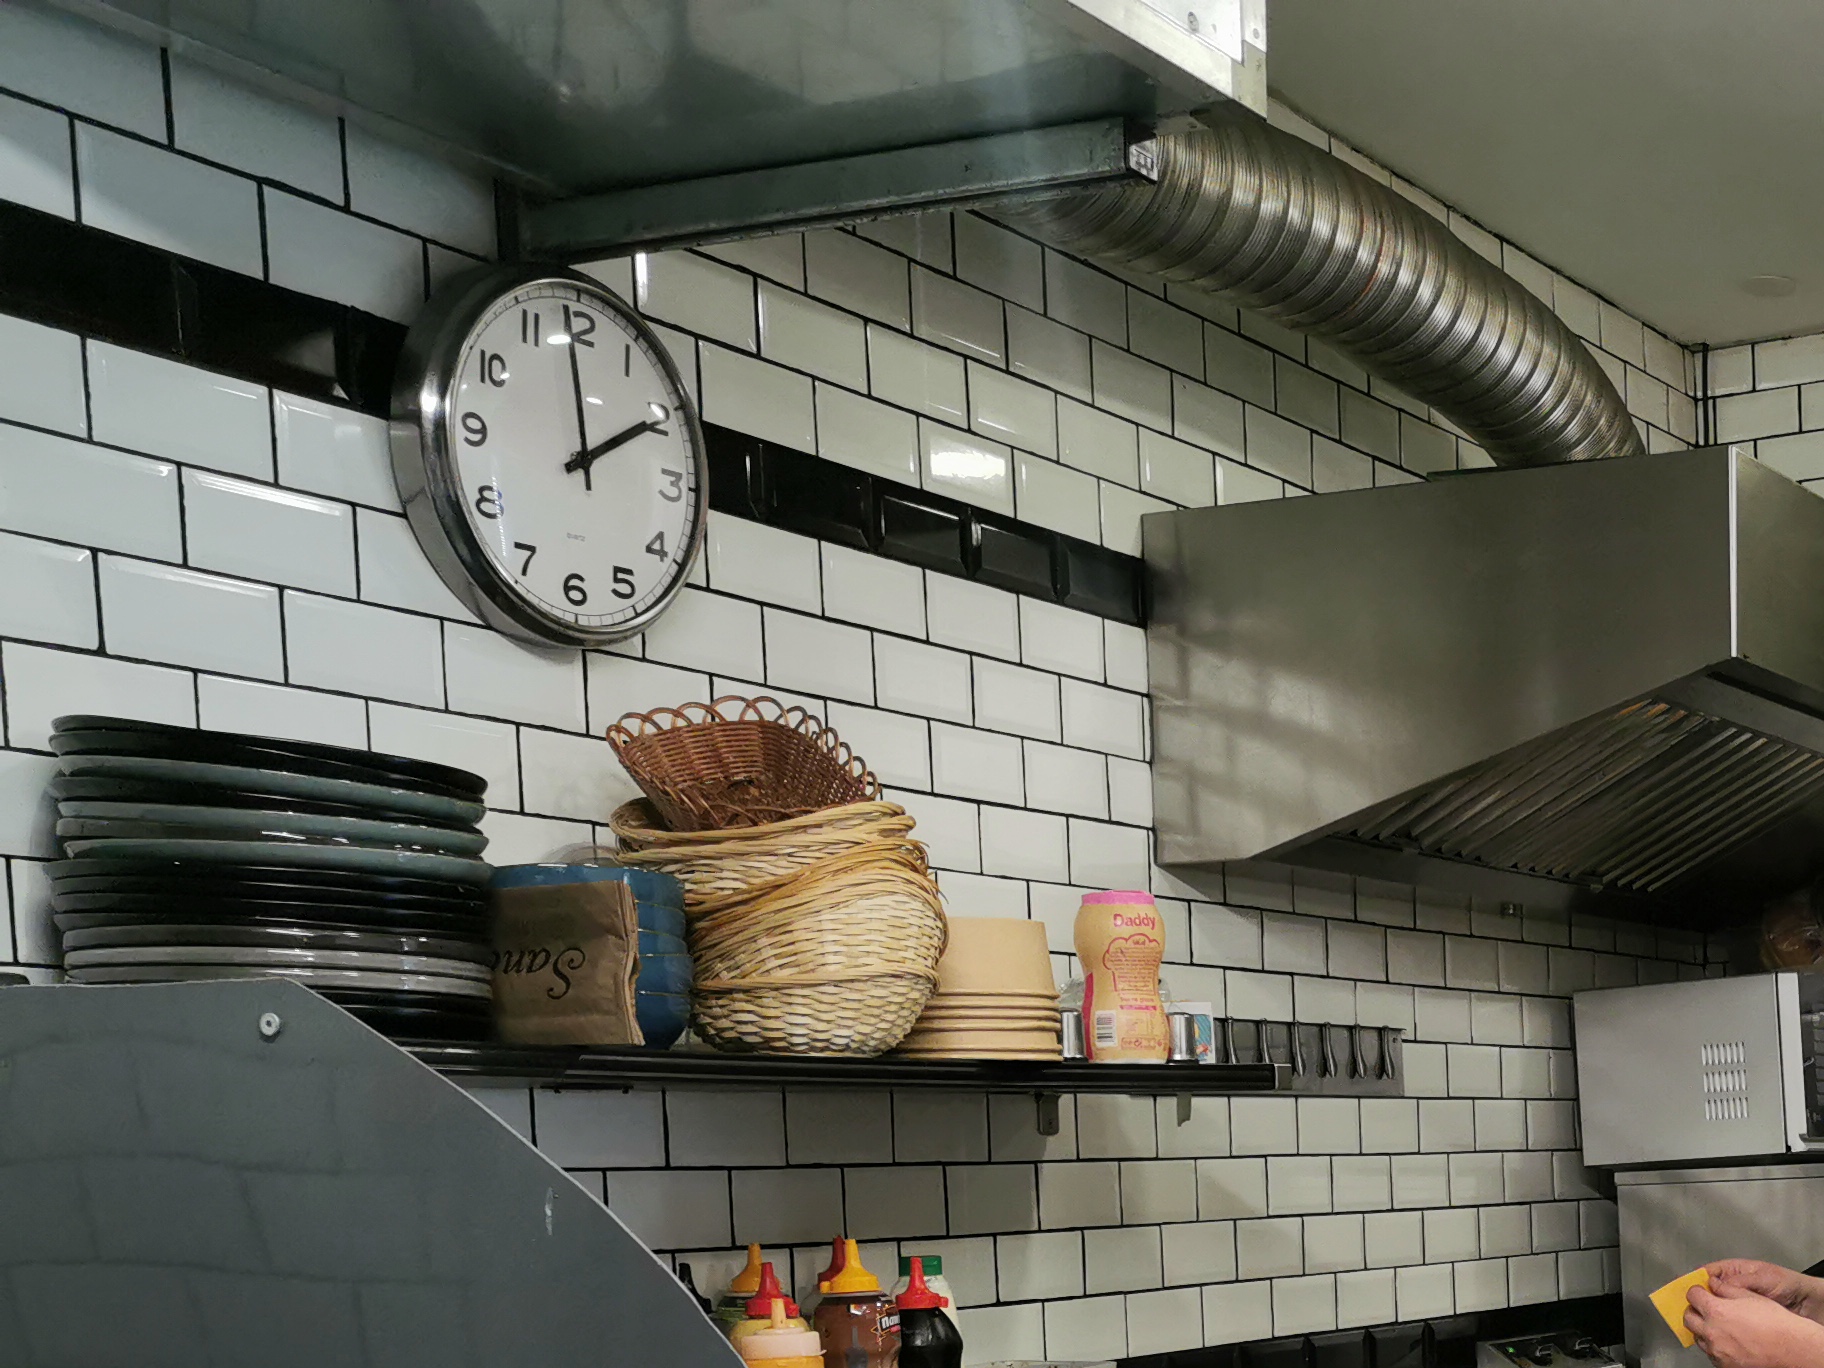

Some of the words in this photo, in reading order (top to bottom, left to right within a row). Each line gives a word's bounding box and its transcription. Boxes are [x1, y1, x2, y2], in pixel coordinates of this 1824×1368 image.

[522, 308, 539, 346] 11
[480, 349, 507, 387] 10
[625, 343, 631, 377] 1
[461, 412, 488, 447] 9
[475, 485, 504, 519] 8
[658, 468, 683, 503] 3
[514, 541, 537, 576] 7
[646, 531, 668, 562] 4
[563, 573, 588, 607] 6
[611, 565, 636, 600] 5
[1113, 912, 1156, 931] Daddy
